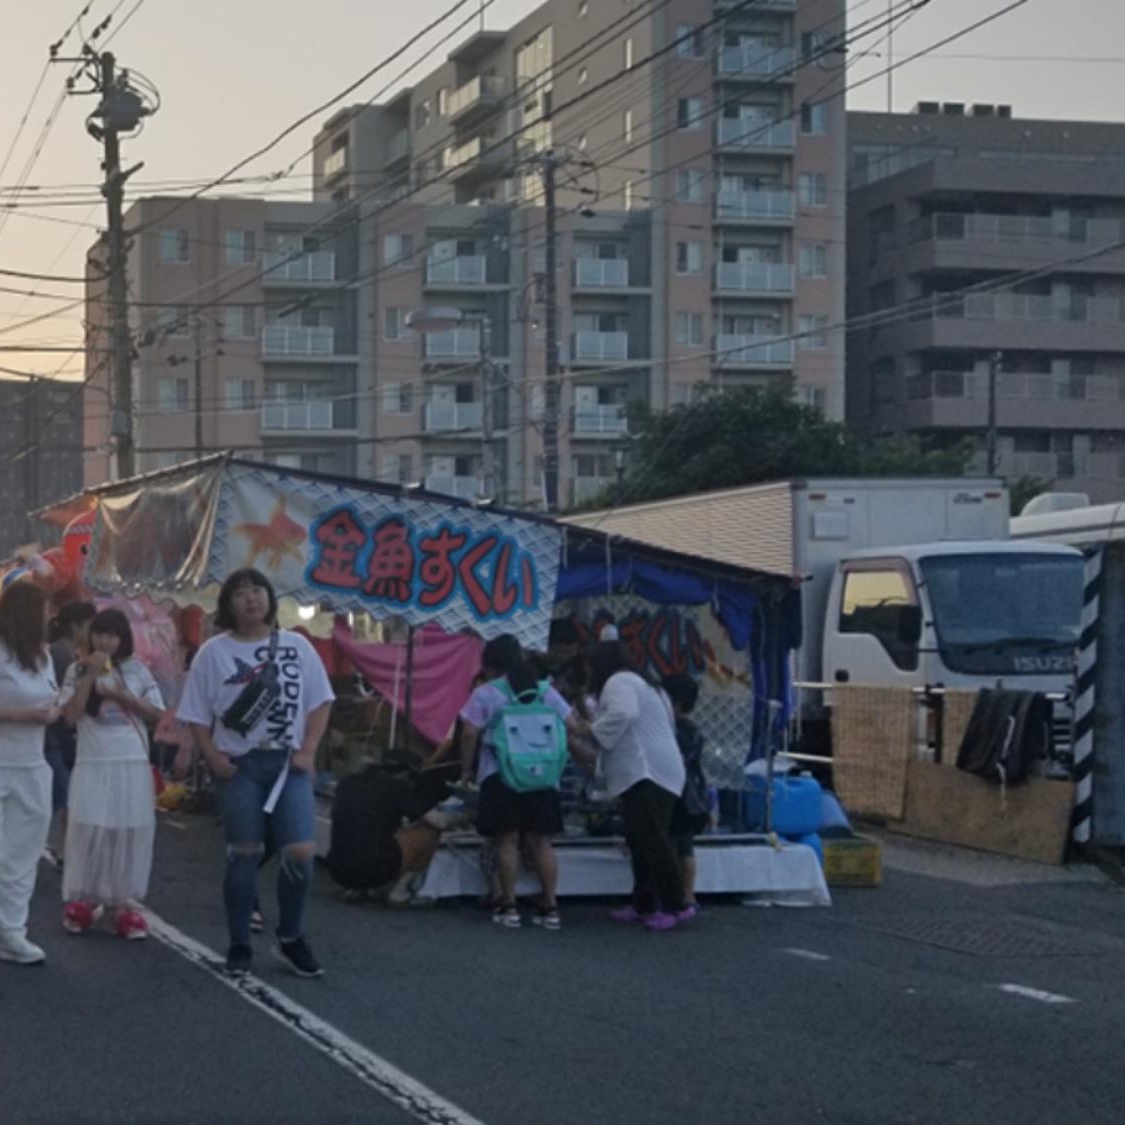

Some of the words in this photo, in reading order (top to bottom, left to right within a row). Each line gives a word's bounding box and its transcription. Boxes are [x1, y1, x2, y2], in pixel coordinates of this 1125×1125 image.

[306, 503, 538, 621] 金魚すくい
